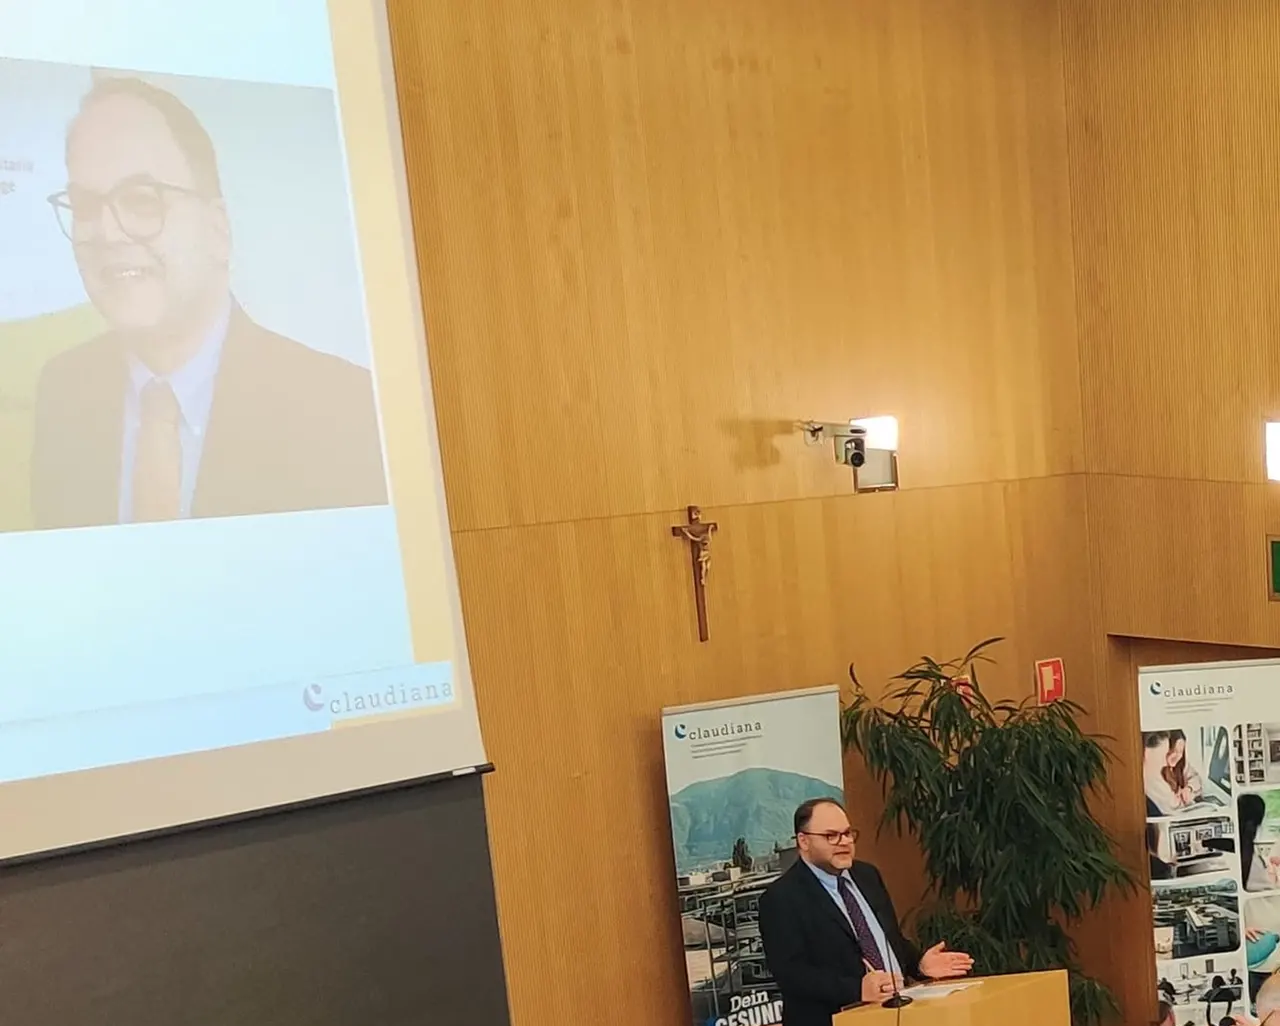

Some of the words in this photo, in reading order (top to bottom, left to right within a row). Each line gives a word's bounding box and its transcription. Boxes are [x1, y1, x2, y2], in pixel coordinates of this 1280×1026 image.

[329, 682, 454, 714] claudiana
[1164, 683, 1234, 698] claudiana
[689, 721, 762, 740] claudiana
[730, 989, 769, 1013] Dein
